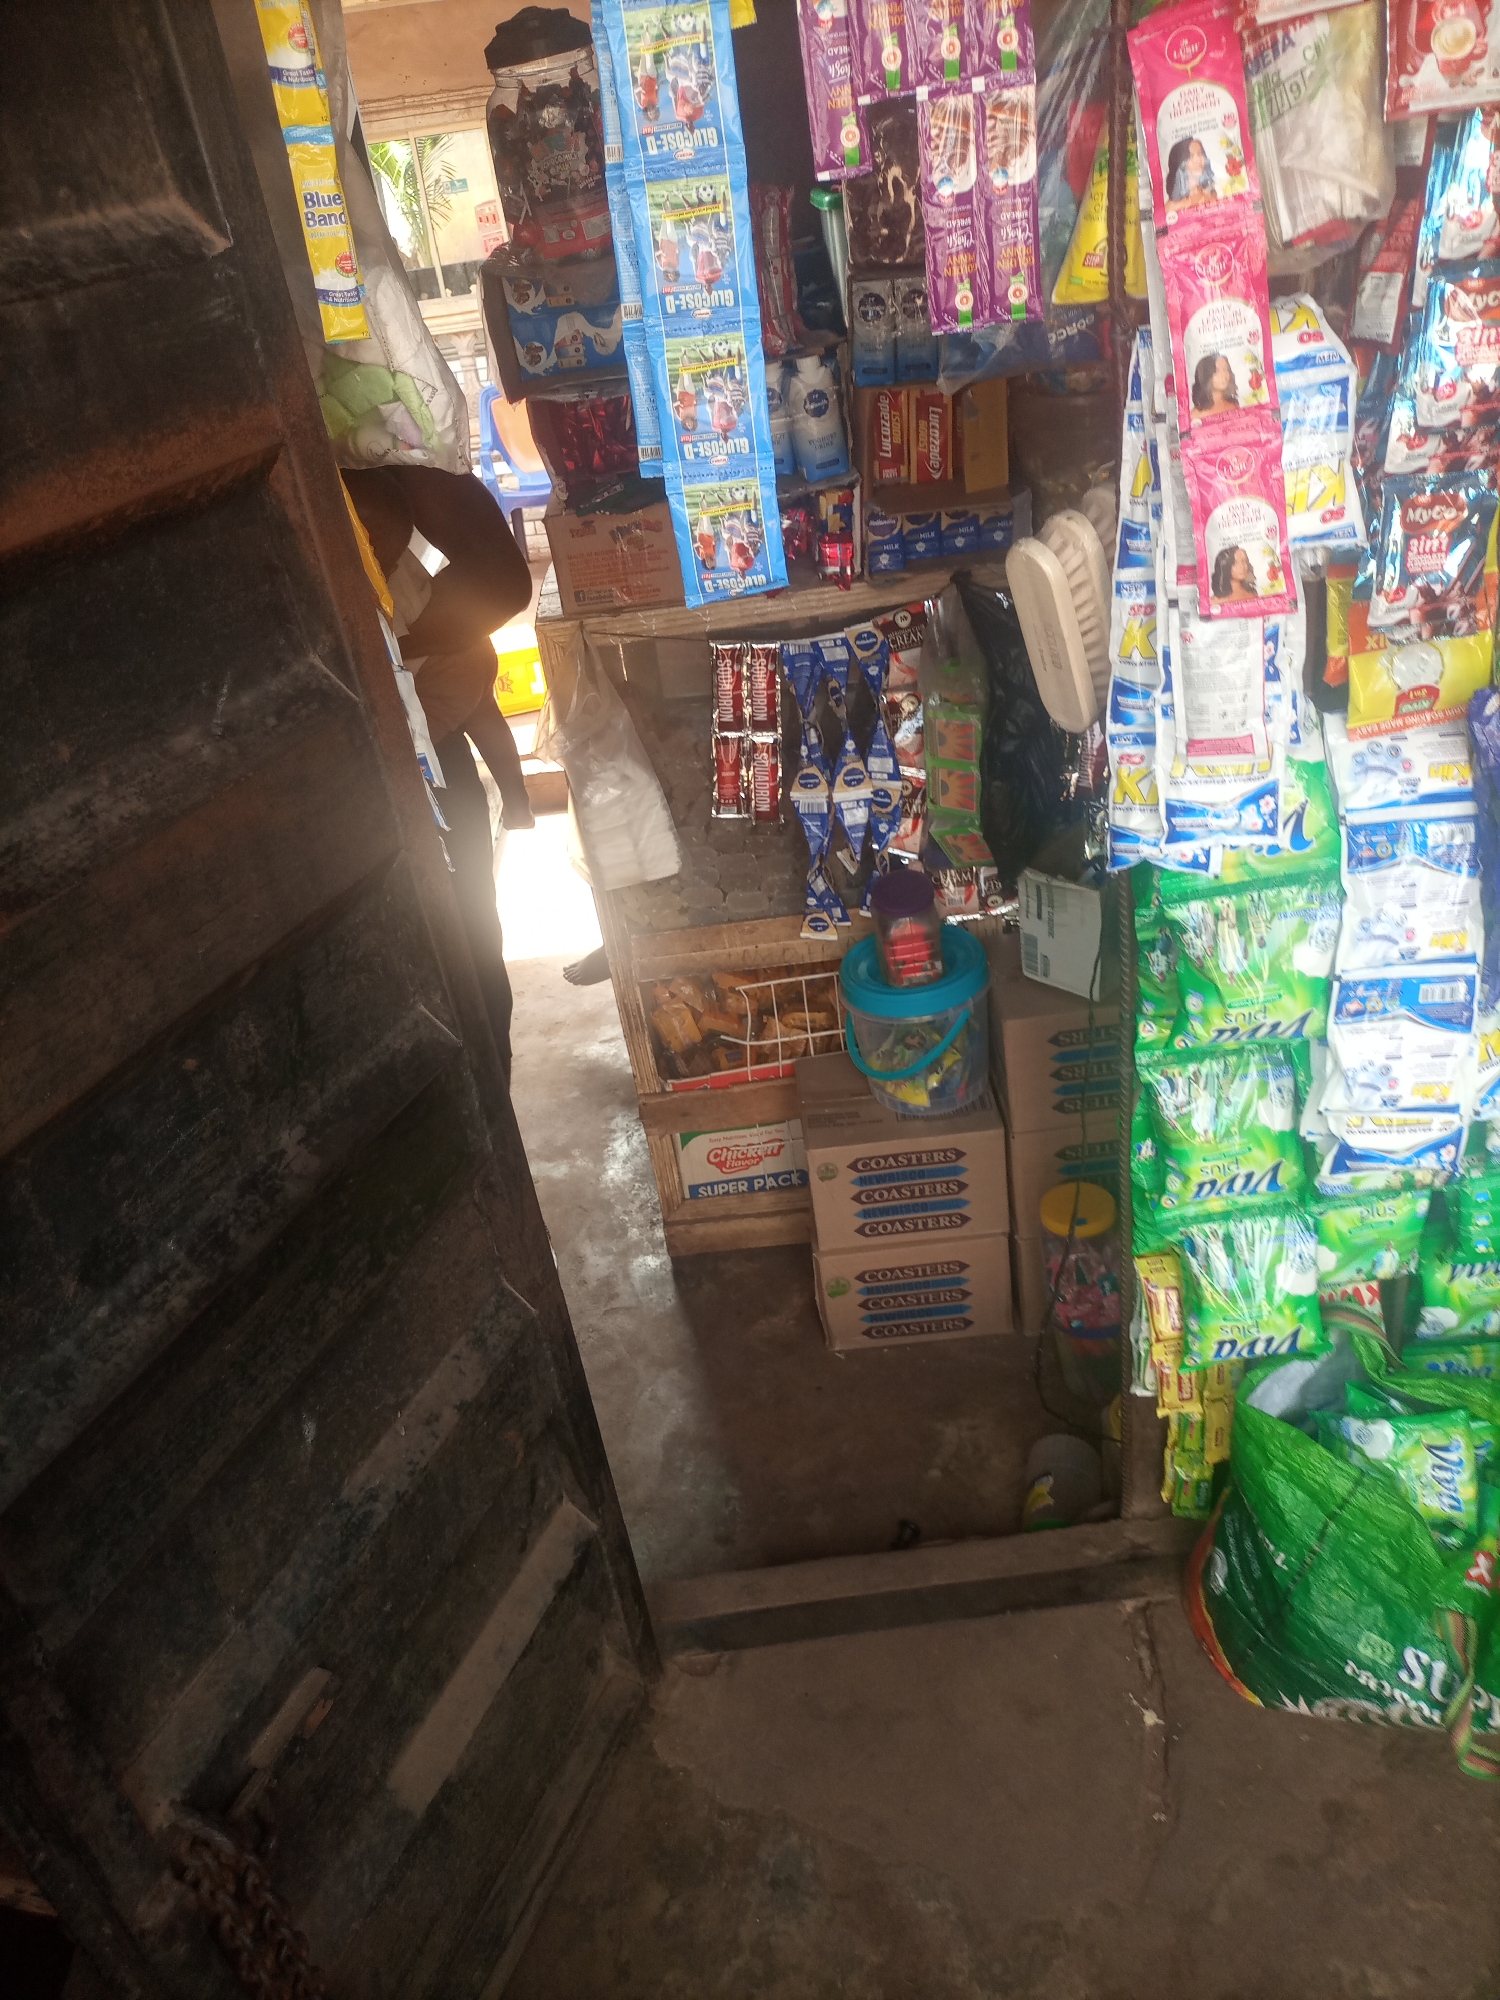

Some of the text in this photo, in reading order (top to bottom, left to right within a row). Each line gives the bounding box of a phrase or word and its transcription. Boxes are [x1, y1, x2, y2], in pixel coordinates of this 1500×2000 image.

[646, 127, 718, 154] GLUCOSE-D
[303, 192, 343, 209] Blue
[666, 289, 734, 314] GLUCOSE-D
[878, 394, 892, 458] Lucozade
[929, 406, 942, 469] Lucozade
[684, 438, 750, 460] GLUCOSE-D
[920, 531, 936, 539] MILK
[958, 525, 975, 534] MILK
[884, 543, 900, 551] MILK
[717, 659, 733, 722] SQUADRON
[751, 658, 767, 721] SQUADRON
[753, 752, 770, 812] SQUADRON
[1224, 1004, 1268, 1025] plus
[725, 1158, 759, 1168] Flavor
[857, 1149, 957, 1171] COASTERS
[1200, 1159, 1240, 1177] plus
[698, 1172, 803, 1198] SUPER PACK
[860, 1181, 959, 1203] COASTERS
[864, 1214, 962, 1236] COASTERS
[864, 1262, 960, 1283] COASTERS
[868, 1289, 963, 1309] COASTERS
[871, 1318, 965, 1338] COASTERS
